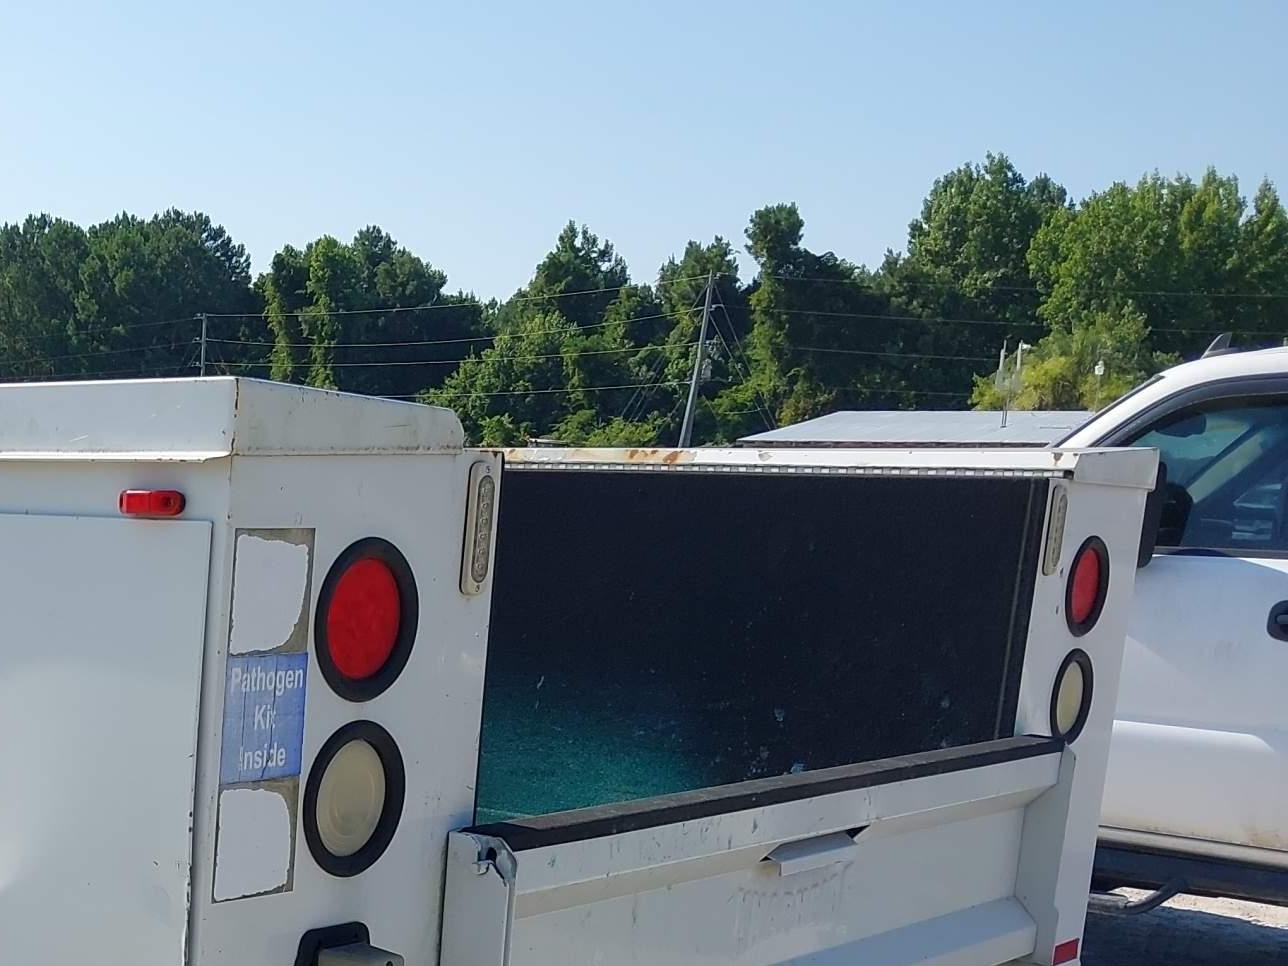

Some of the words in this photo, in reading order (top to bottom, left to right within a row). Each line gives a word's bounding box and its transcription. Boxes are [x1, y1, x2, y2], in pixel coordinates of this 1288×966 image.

[230, 667, 304, 697] Pathogen
[253, 704, 277, 730] Kit
[239, 743, 286, 770] Inside
